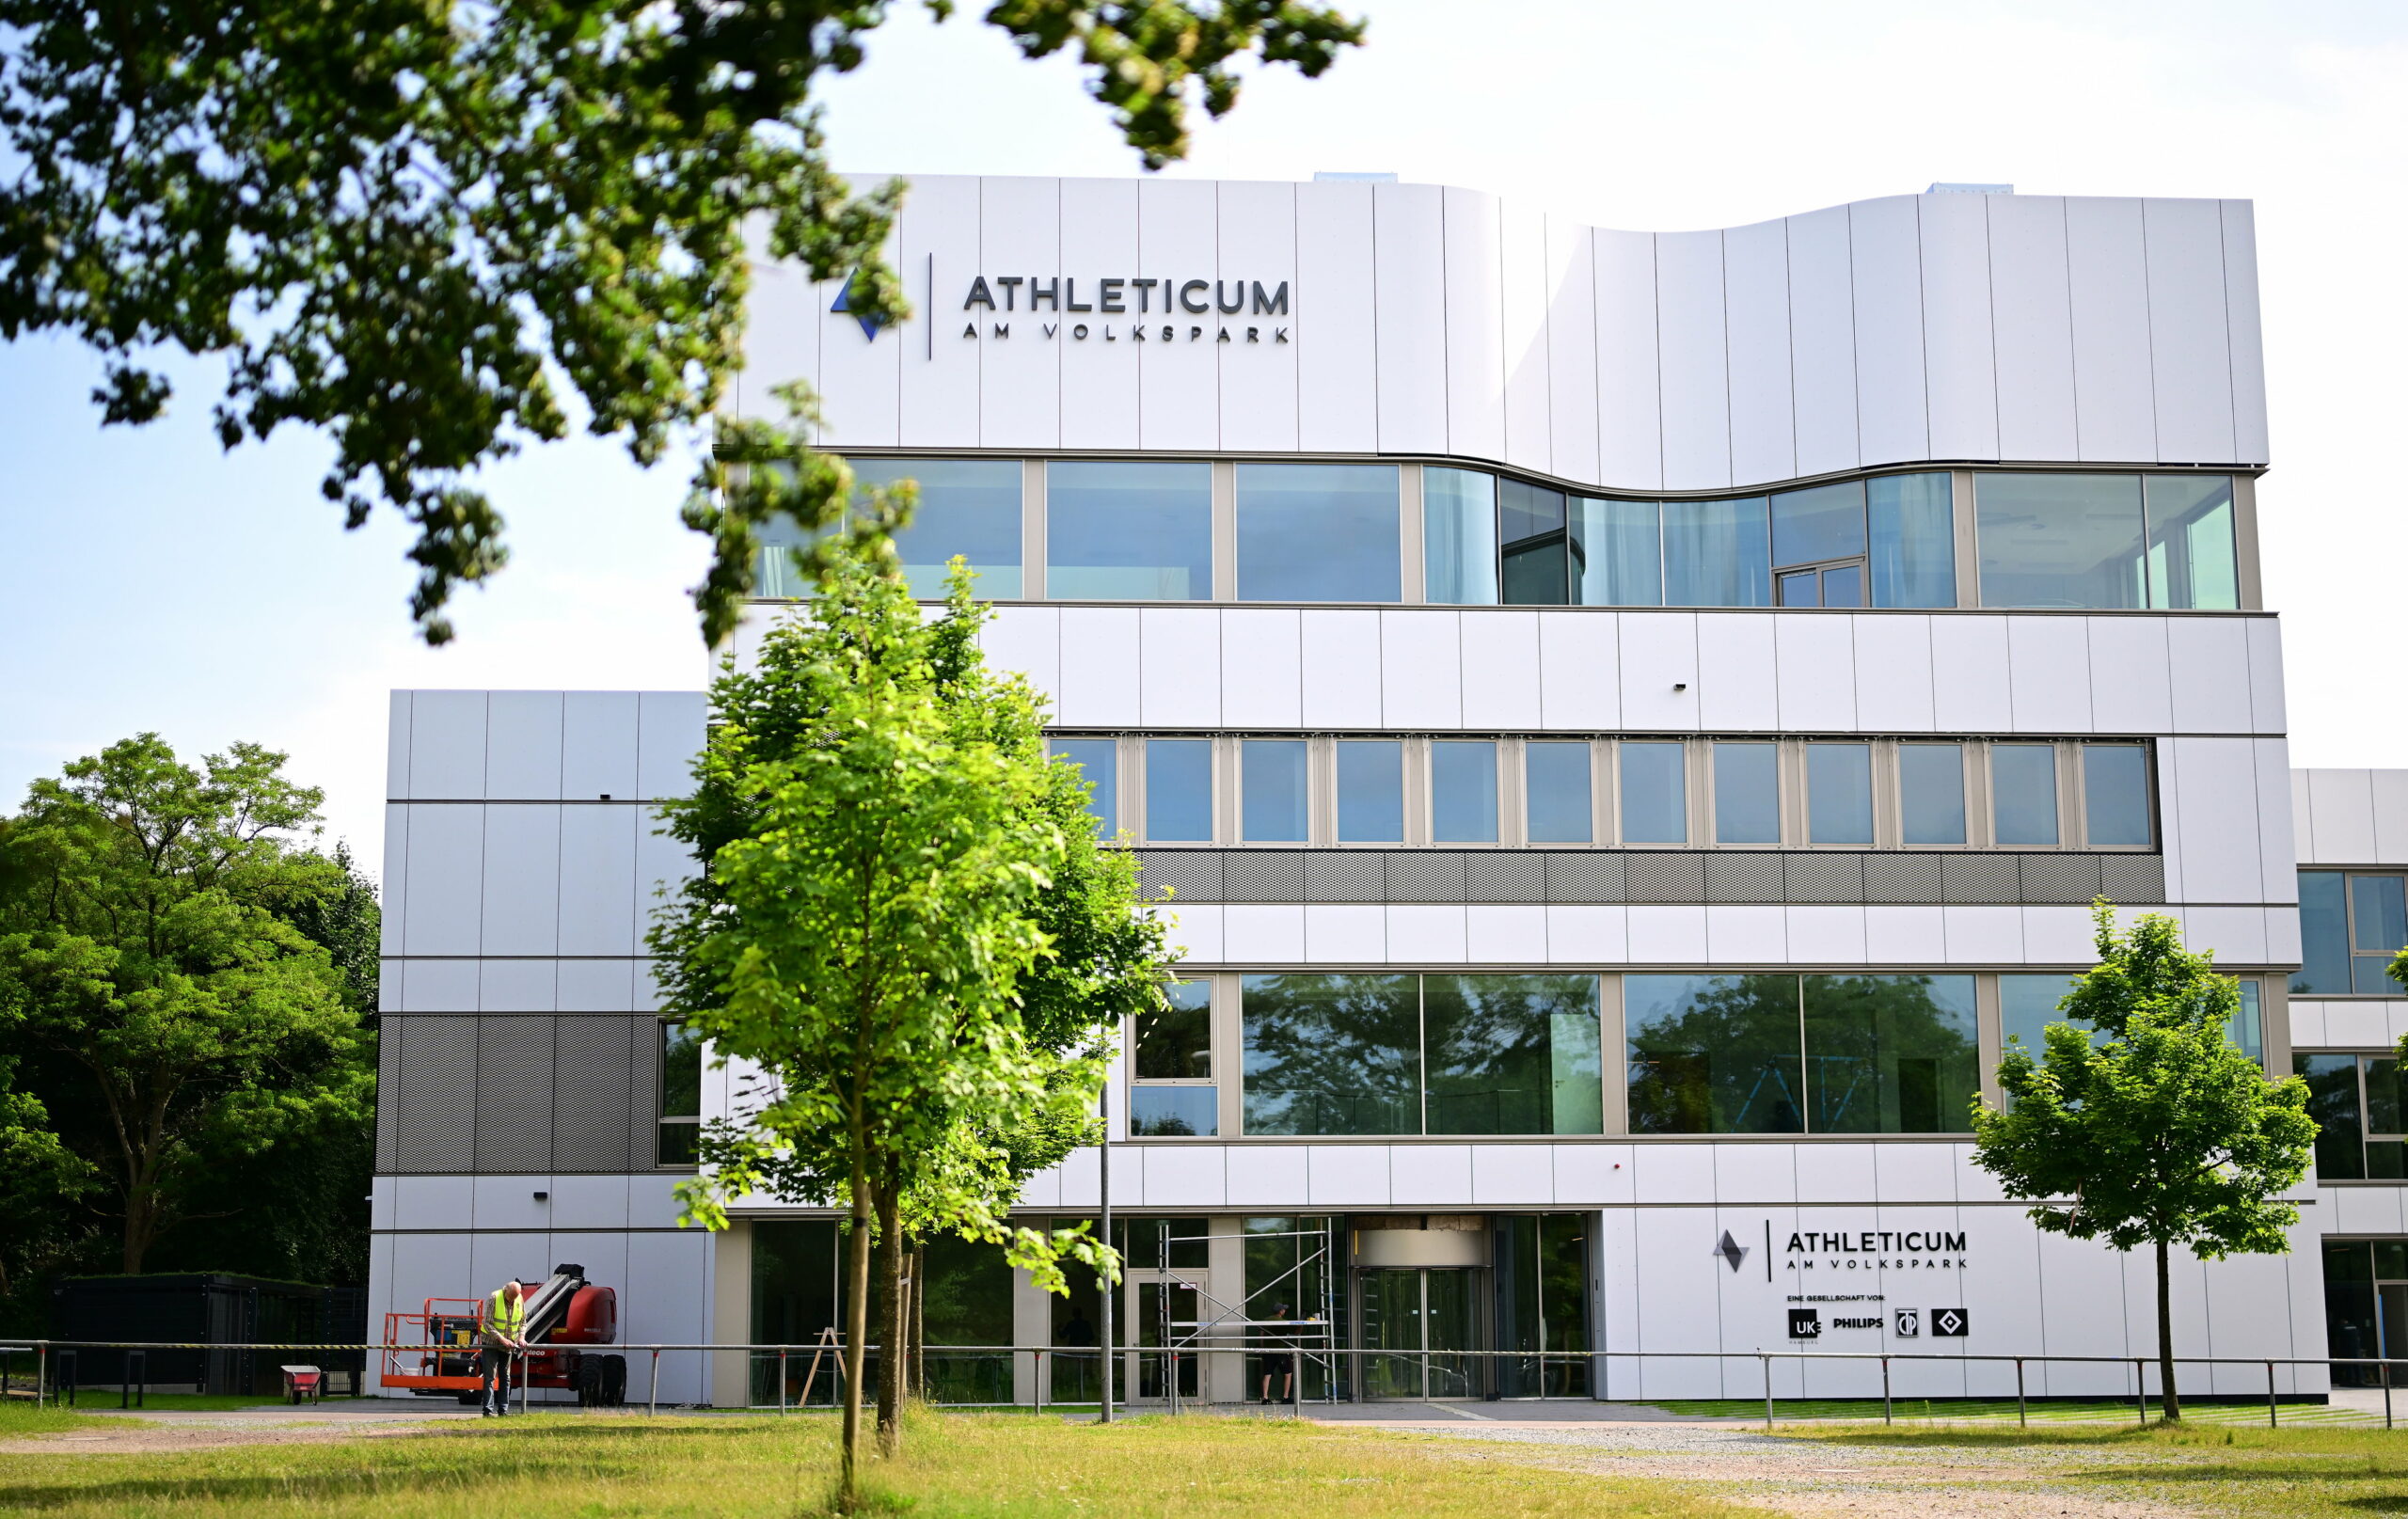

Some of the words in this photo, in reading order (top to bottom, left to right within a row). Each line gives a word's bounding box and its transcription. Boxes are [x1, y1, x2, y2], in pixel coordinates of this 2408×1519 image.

[963, 276, 1289, 315] ATHLETICUM
[962, 322, 1009, 340] AM
[1043, 323, 1289, 343] VOLKSPARK
[1787, 1231, 1967, 1252] ATHLETICUM
[1787, 1259, 1814, 1269] AM
[1830, 1258, 1968, 1269] VOLKSPARK
[1796, 1321, 1822, 1335] UKE
[1833, 1318, 1884, 1329] PHILIPS
